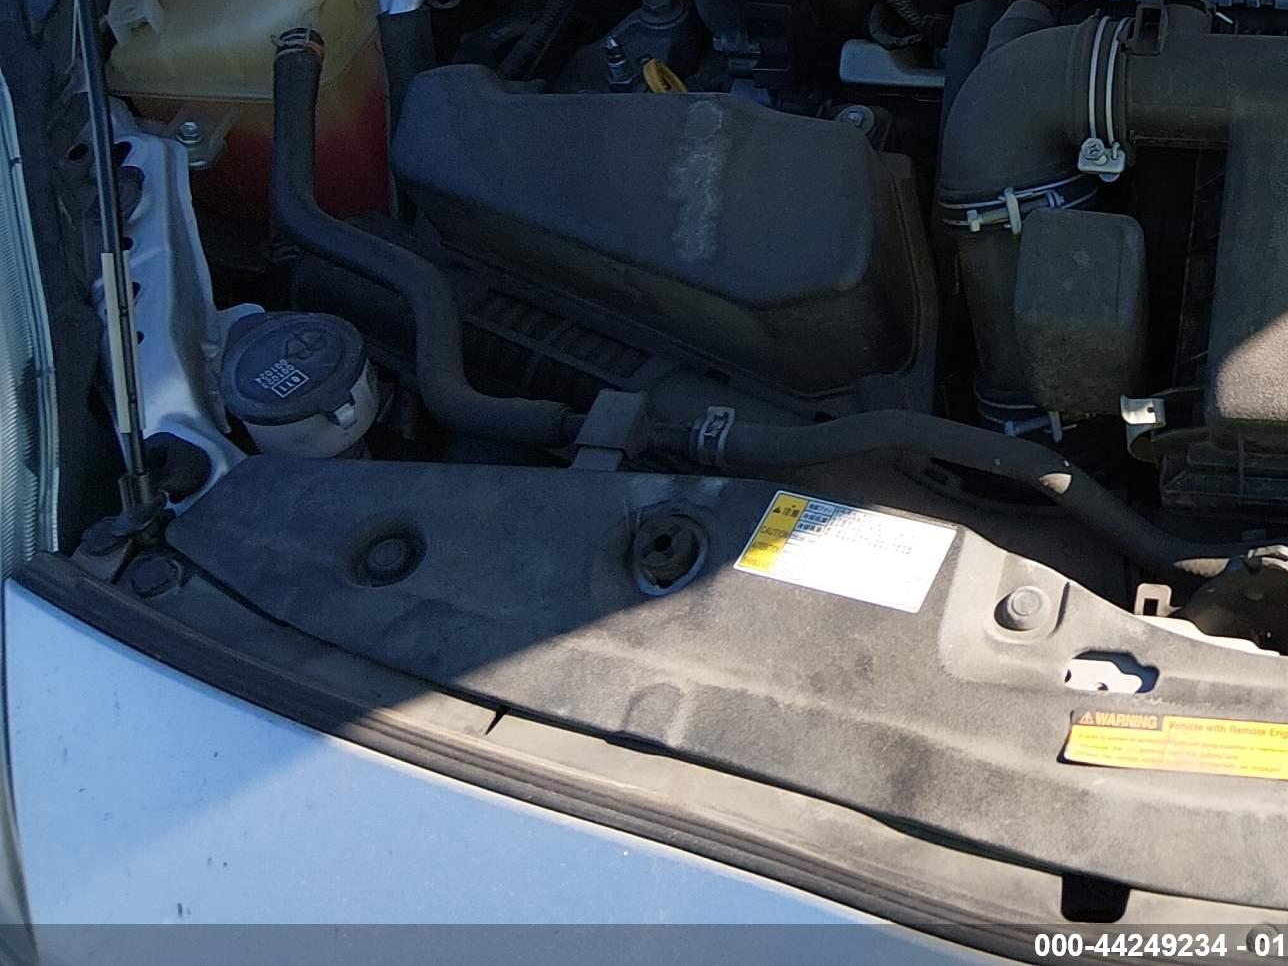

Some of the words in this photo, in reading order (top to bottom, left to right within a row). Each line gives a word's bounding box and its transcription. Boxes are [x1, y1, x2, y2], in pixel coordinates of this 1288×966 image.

[1095, 712, 1158, 730] WARNING
[1206, 724, 1226, 733] with
[1229, 725, 1266, 736] Remote
